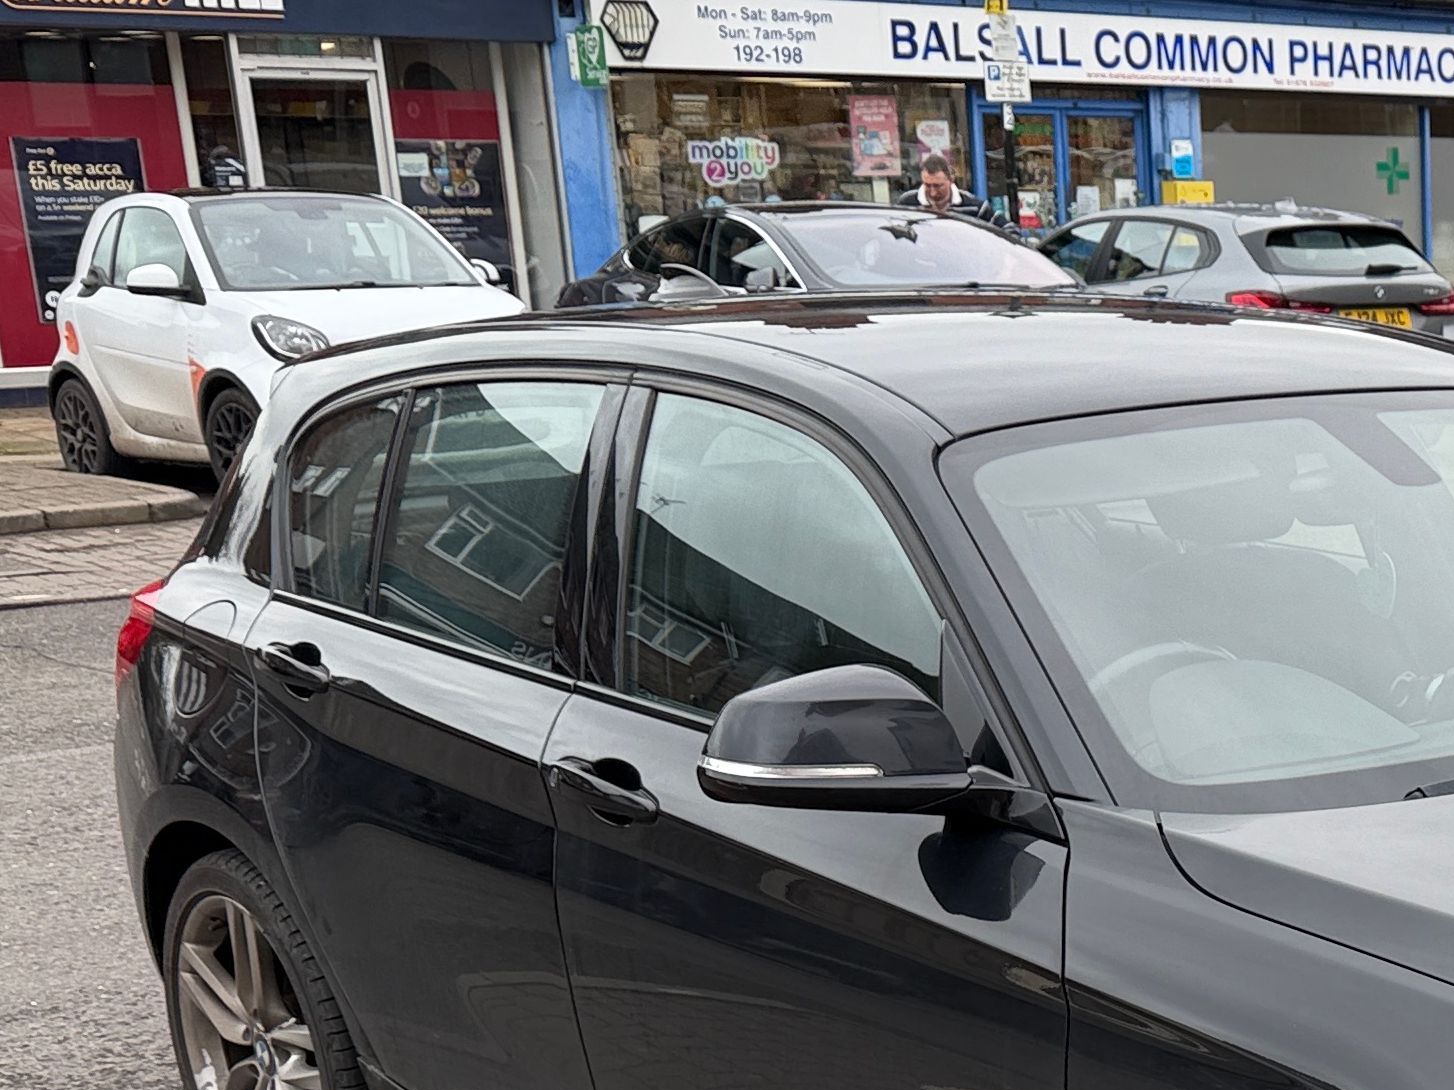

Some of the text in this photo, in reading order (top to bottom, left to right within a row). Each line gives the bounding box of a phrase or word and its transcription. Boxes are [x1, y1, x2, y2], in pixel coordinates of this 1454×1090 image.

[696, 5, 727, 20] Mon
[740, 6, 767, 22] Sat:
[771, 9, 833, 26] 8am-9pm
[718, 24, 816, 43] Sun: 7am-5pm
[733, 43, 803, 64] 192-198
[890, 18, 1081, 67] BALSALL
[1094, 28, 1275, 76] COMMON
[691, 141, 776, 165] mobility
[28, 159, 123, 175] £5 free acca
[30, 175, 135, 193] this Saturday
